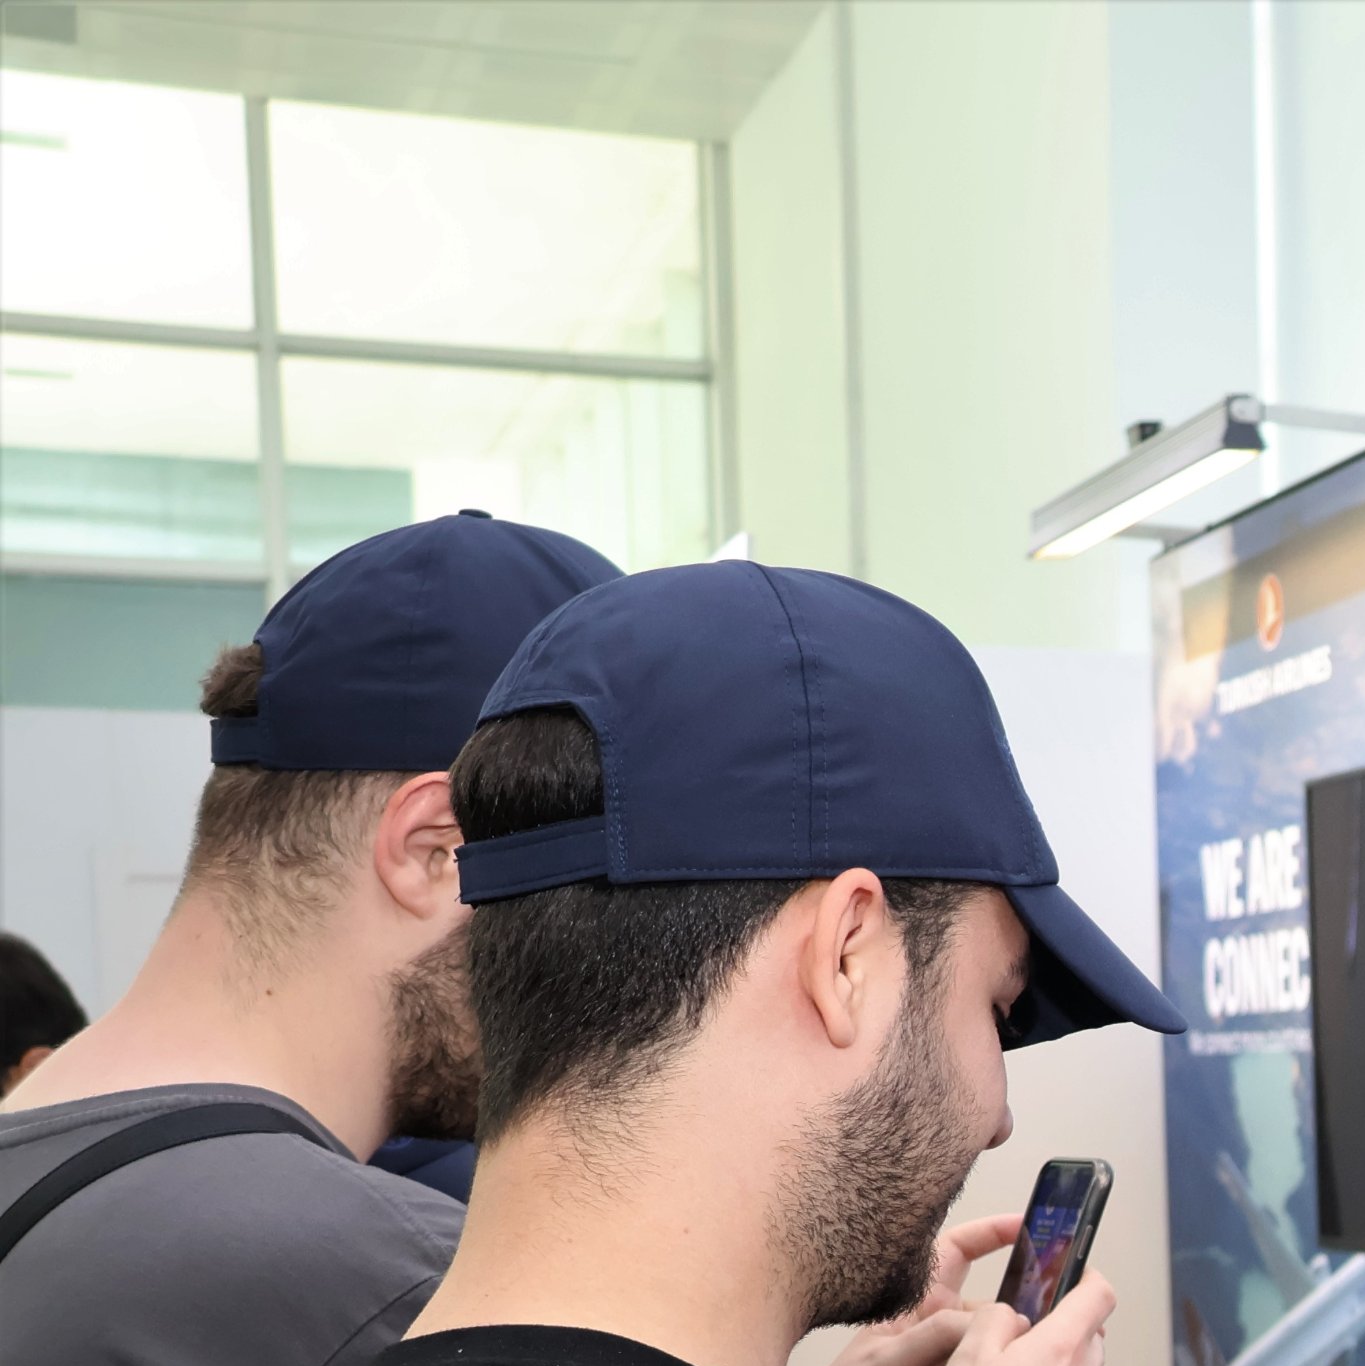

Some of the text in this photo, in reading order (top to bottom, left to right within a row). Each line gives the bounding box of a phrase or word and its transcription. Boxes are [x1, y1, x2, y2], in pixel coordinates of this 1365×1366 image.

[1201, 823, 1302, 921] WE ARE
[1203, 925, 1311, 1018] CONNEC
